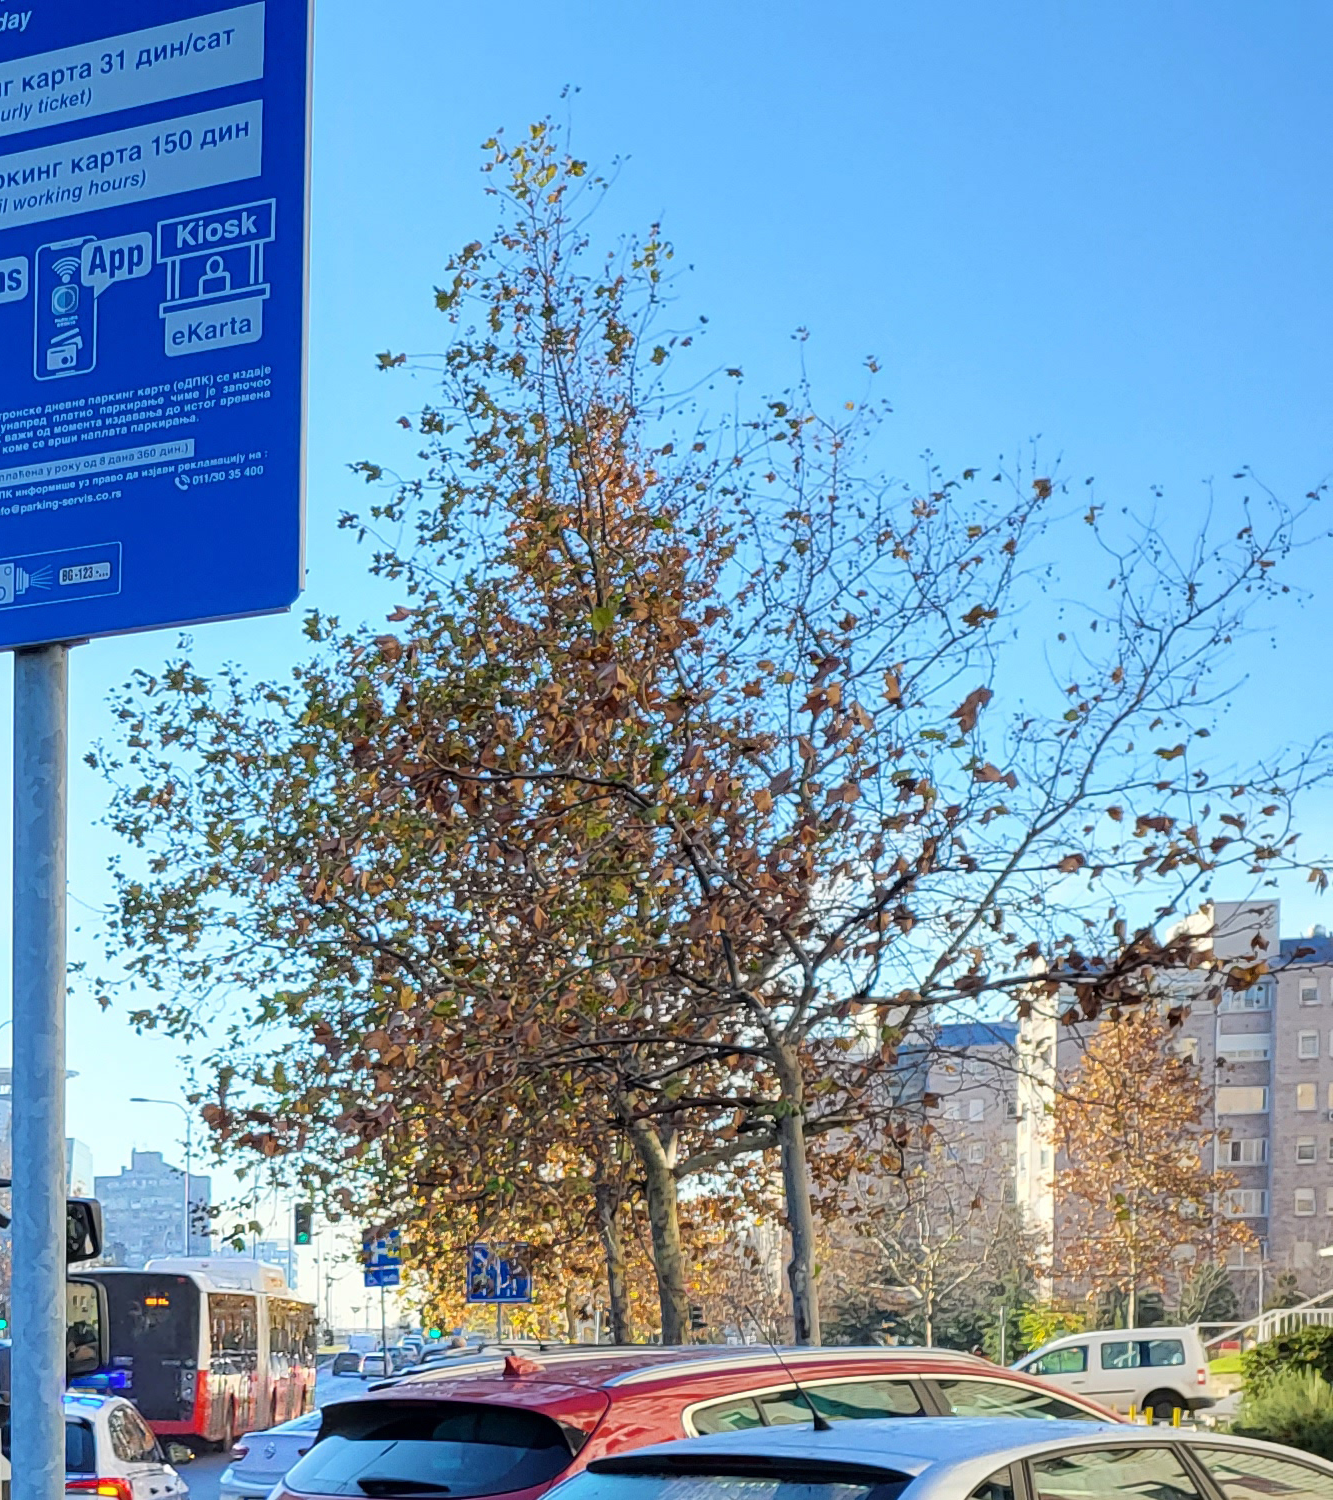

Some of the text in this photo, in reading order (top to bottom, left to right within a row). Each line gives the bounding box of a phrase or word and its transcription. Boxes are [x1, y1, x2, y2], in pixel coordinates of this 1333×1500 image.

[21, 62, 92, 93] карта
[100, 50, 126, 74] 31
[135, 28, 236, 70] дин/сат
[37, 87, 92, 114] ticket)
[71, 144, 142, 173] карта
[151, 129, 193, 157] 150
[199, 121, 250, 149] дин
[13, 184, 83, 212] working
[88, 169, 147, 196] hours)
[176, 211, 258, 249] Kiosk
[88, 243, 144, 279] App
[171, 317, 252, 347] eKarta
[88, 389, 134, 406] паркинг
[36, 427, 51, 437] од
[165, 405, 181, 417] до
[81, 427, 128, 441] наплата
[46, 467, 53, 476] у
[54, 462, 81, 475] року
[83, 459, 97, 470] од
[99, 457, 106, 466] 8
[108, 454, 134, 465] дана
[136, 449, 157, 460] 360
[159, 443, 189, 458] дин.)
[125, 471, 138, 481] да
[248, 451, 262, 460] на
[192, 465, 264, 485] 011/30 35 400
